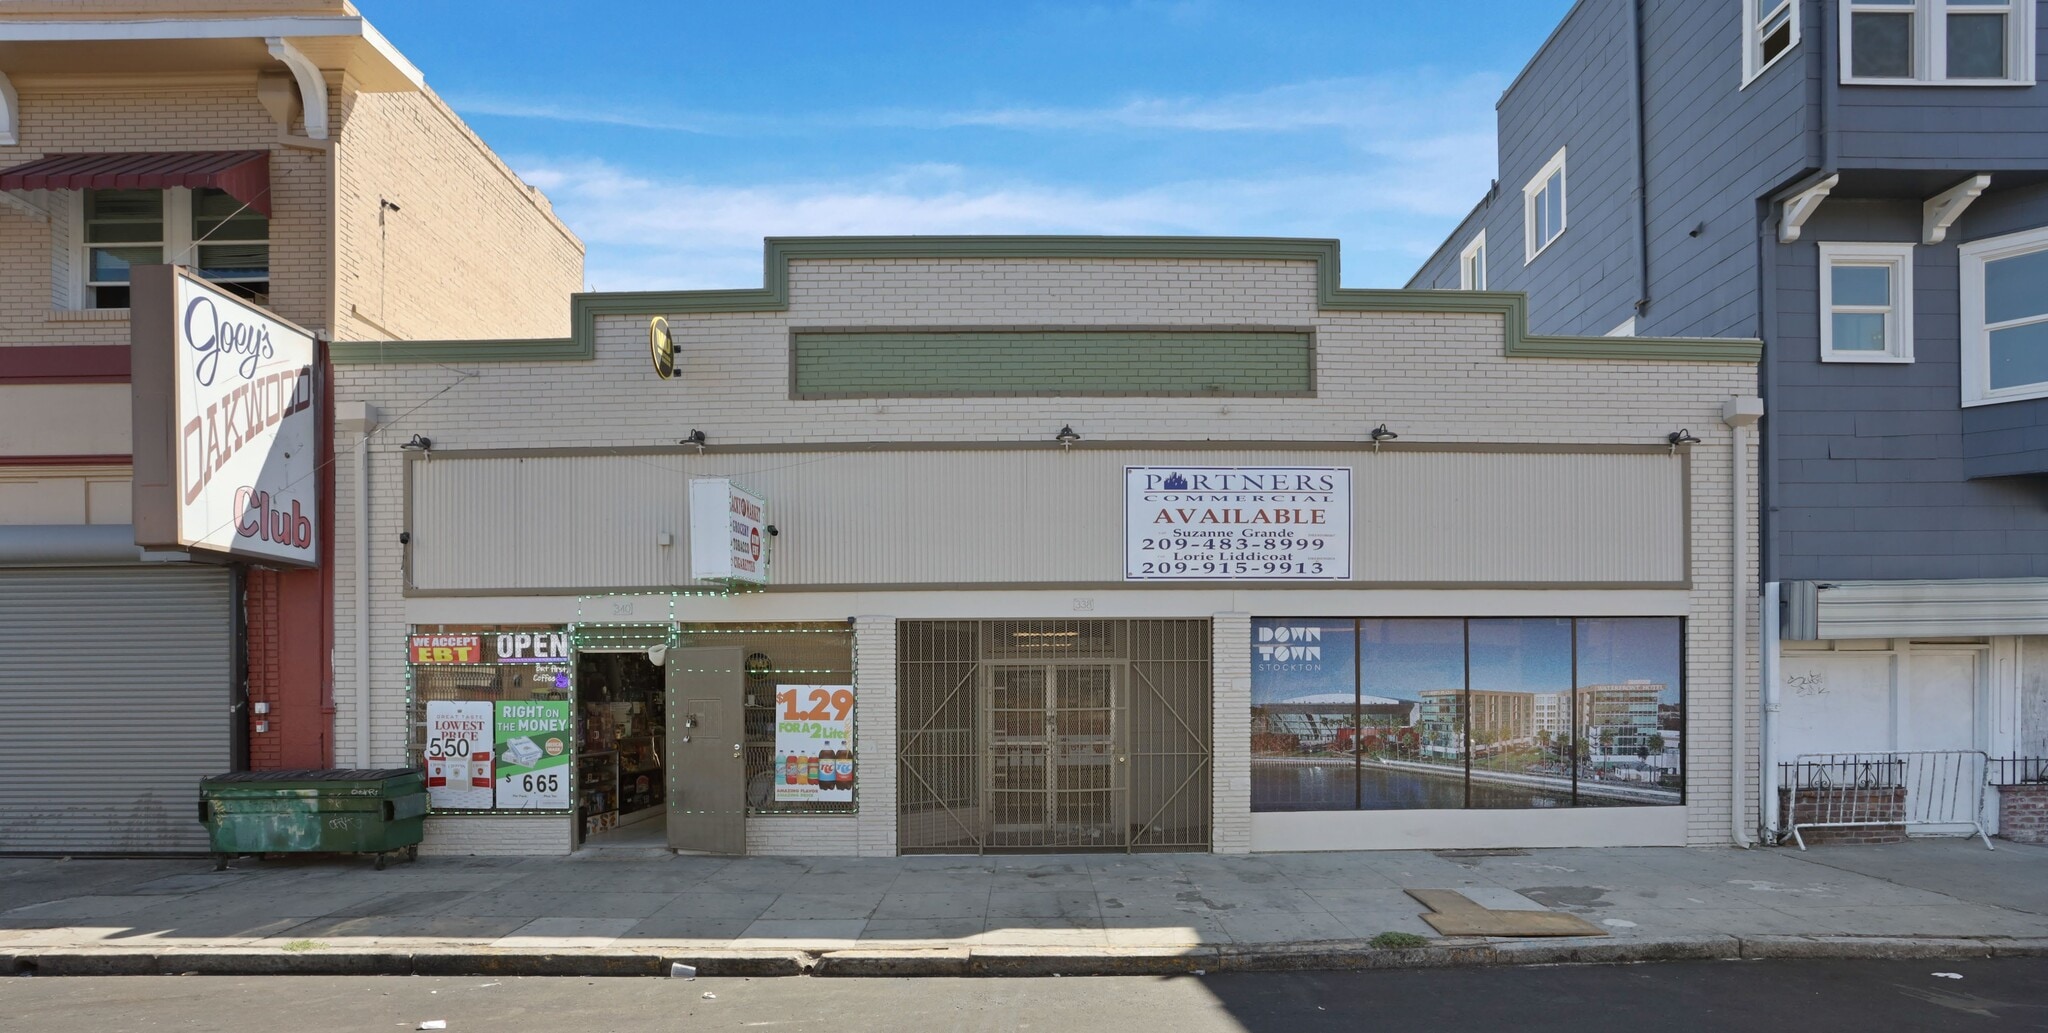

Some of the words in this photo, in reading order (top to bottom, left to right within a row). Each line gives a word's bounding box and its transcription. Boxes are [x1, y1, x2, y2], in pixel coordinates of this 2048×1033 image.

[184, 296, 274, 387] Joey's
[184, 367, 311, 506] OAKWOOD
[1144, 472, 1334, 491] PRTNERS
[233, 485, 311, 550] Club
[1153, 508, 1326, 524] AVAILABLE
[1173, 528, 1234, 538] Suzanne
[1241, 528, 1295, 538] Grande
[1142, 538, 1325, 550] 209-483-8999
[1173, 552, 1214, 561] Lorie
[1219, 552, 1293, 561] Liddicoat
[1142, 562, 1324, 574] 209-915-9913
[1258, 626, 1321, 642] DOWN
[412, 637, 430, 647] WE
[432, 637, 478, 647] ACCEPT
[497, 634, 568, 658] OPEN
[418, 647, 473, 662] EBT
[1258, 646, 1321, 661] TOWN
[1258, 663, 1321, 671] STOCKTON
[503, 705, 544, 718] RIGHT
[545, 709, 560, 718] ON
[435, 720, 485, 731] LOWEST
[497, 722, 516, 731] THE
[518, 719, 567, 731] MONEY
[778, 722, 799, 733] FOR
[801, 722, 810, 733] A
[810, 722, 821, 739] 2
[441, 731, 479, 741] PRICE
